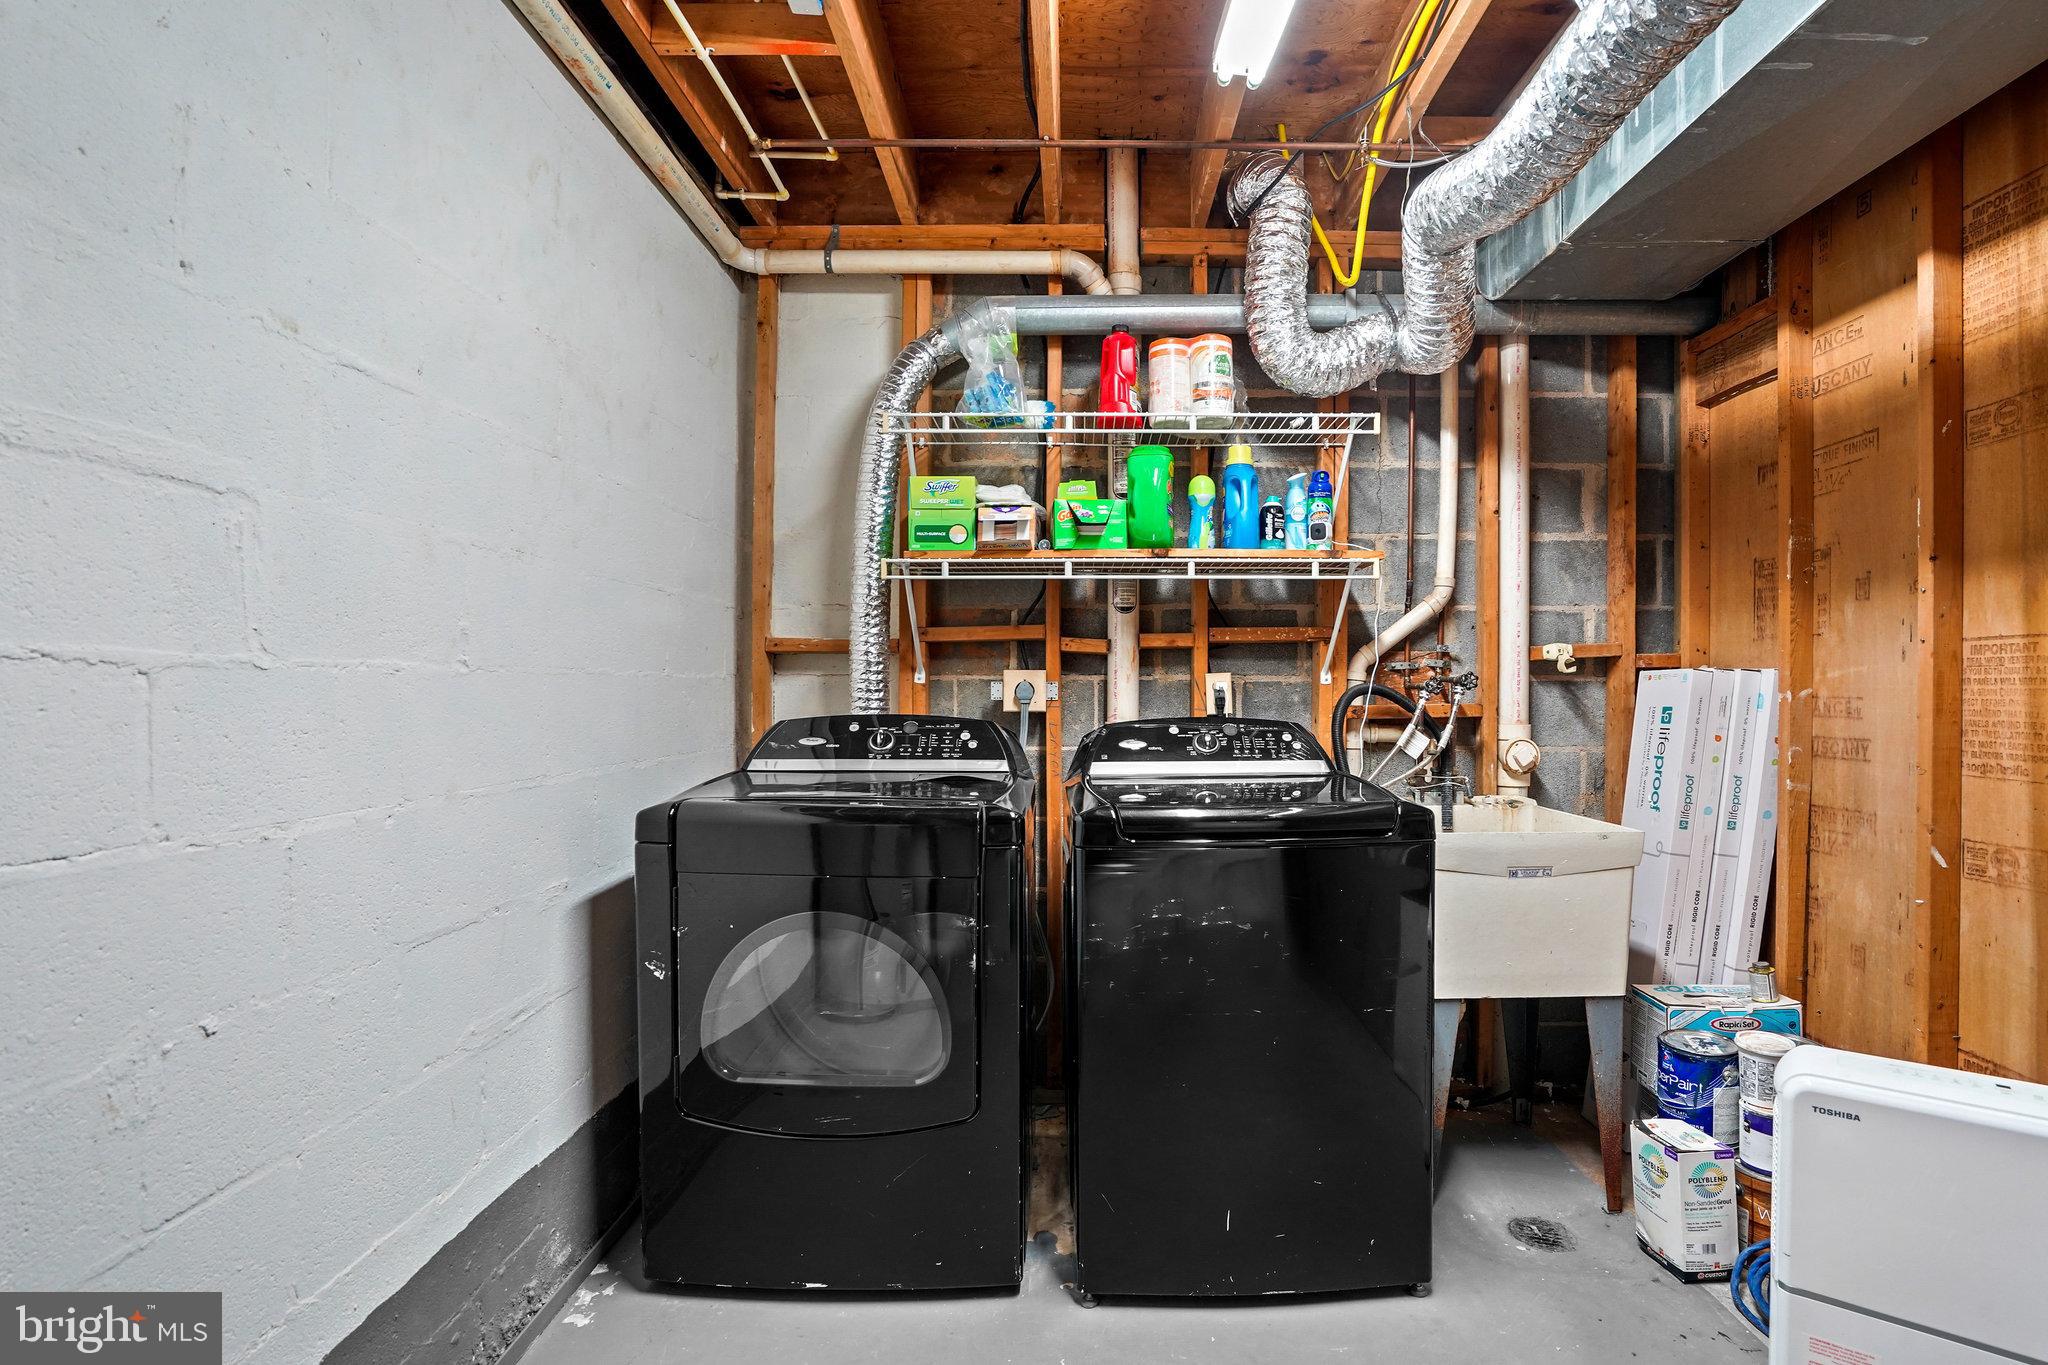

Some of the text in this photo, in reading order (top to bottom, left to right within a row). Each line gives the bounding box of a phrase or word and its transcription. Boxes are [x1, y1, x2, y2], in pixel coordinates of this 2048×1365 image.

[1972, 174, 2042, 219] IMPORTANT
[1987, 205, 2008, 220] WOOD
[924, 480, 959, 493] Swiffer
[1970, 642, 2039, 656] IMPORTANT
[1650, 727, 1671, 812] lifeproof
[1681, 774, 1694, 819] lifeproof
[1729, 775, 1743, 820] lifeproof
[1752, 895, 1760, 911] CORE
[1742, 1020, 1755, 1029] Set
[1812, 1106, 1861, 1121] TOSHIBA
[1638, 1153, 1669, 1178] POLYBLEND
[1688, 1175, 1728, 1184] POLYBLEND
